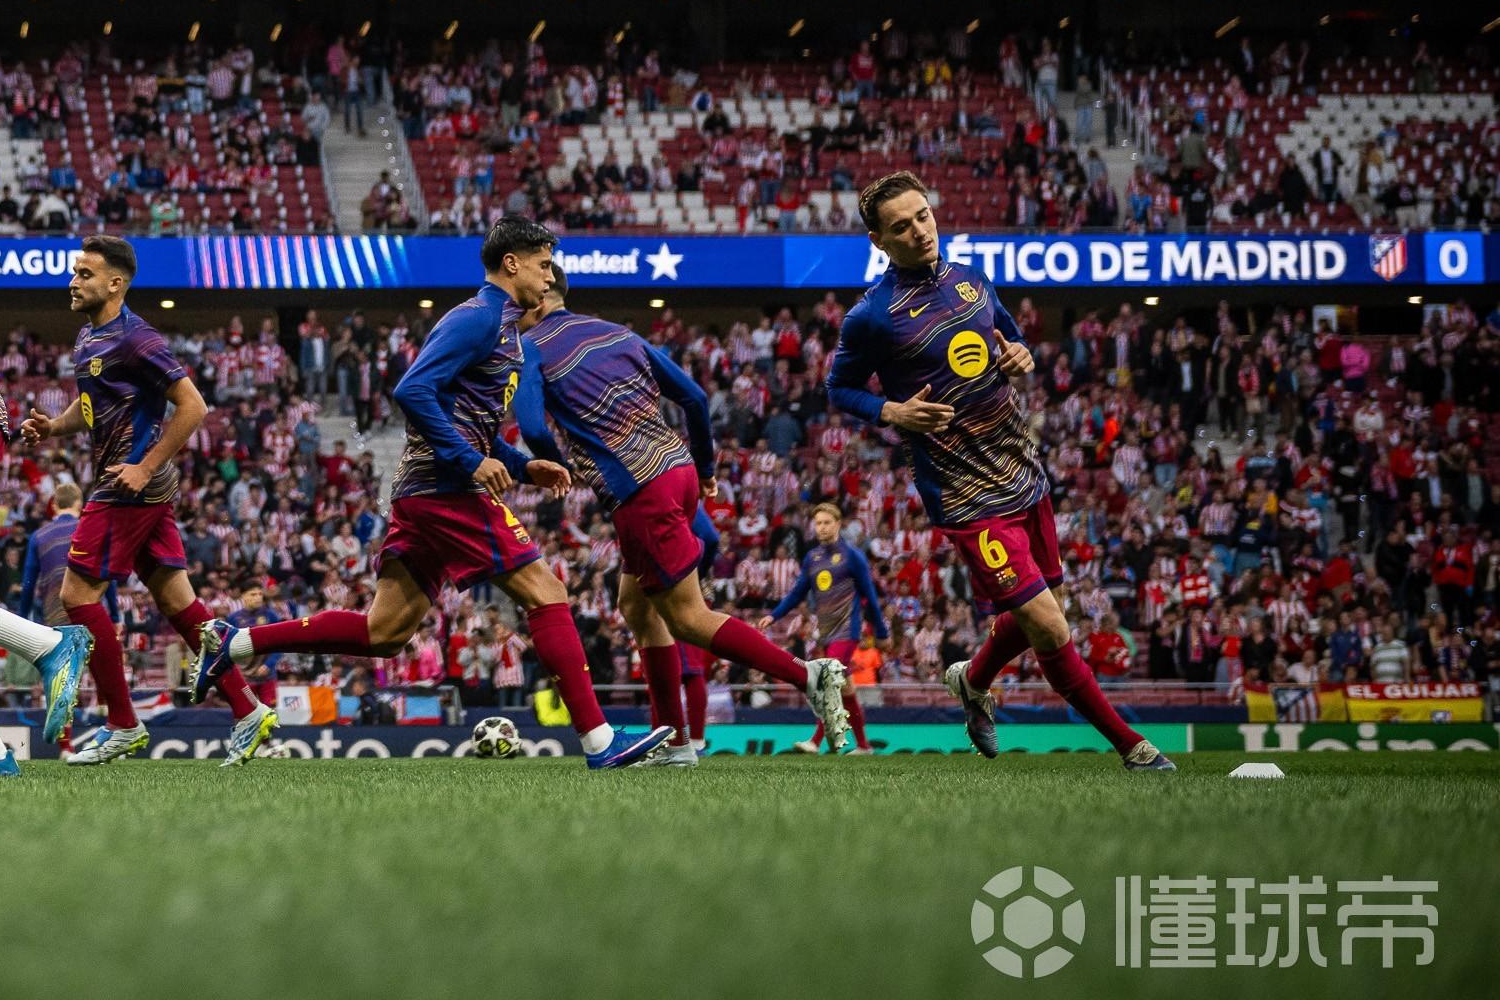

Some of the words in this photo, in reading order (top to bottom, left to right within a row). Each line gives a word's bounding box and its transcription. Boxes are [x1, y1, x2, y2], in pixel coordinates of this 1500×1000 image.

[1093, 241, 1148, 281] DE
[1161, 240, 1347, 280] MADRID
[1439, 240, 1468, 277] 0
[979, 528, 1008, 568] 6
[1346, 684, 1379, 699] EL
[1383, 683, 1480, 699] GUIJAR
